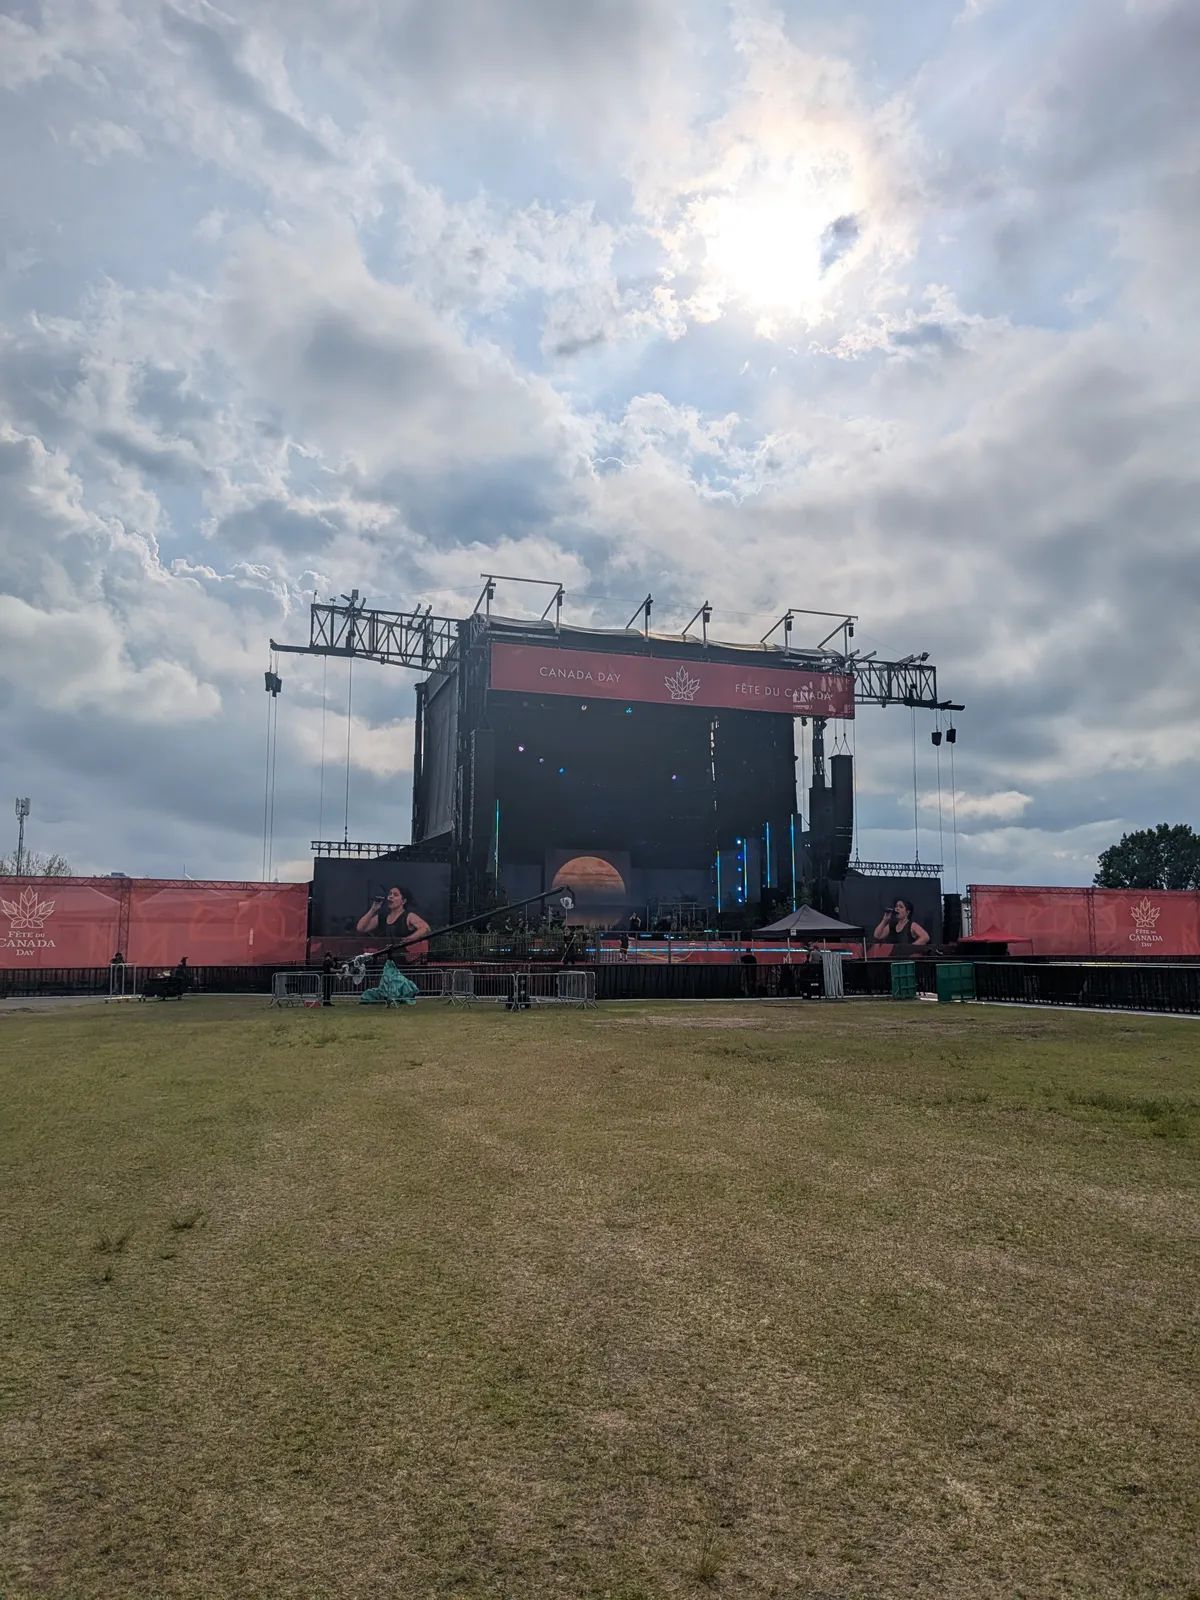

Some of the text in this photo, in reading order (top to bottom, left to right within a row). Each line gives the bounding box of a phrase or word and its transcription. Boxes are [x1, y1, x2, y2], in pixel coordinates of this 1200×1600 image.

[539, 666, 621, 683] CANADA DAY
[735, 682, 832, 701] FÊTE DU CANADA
[8, 930, 33, 938] FÊTE
[1129, 933, 1163, 941] CANADA
[0, 937, 56, 948] CANADA
